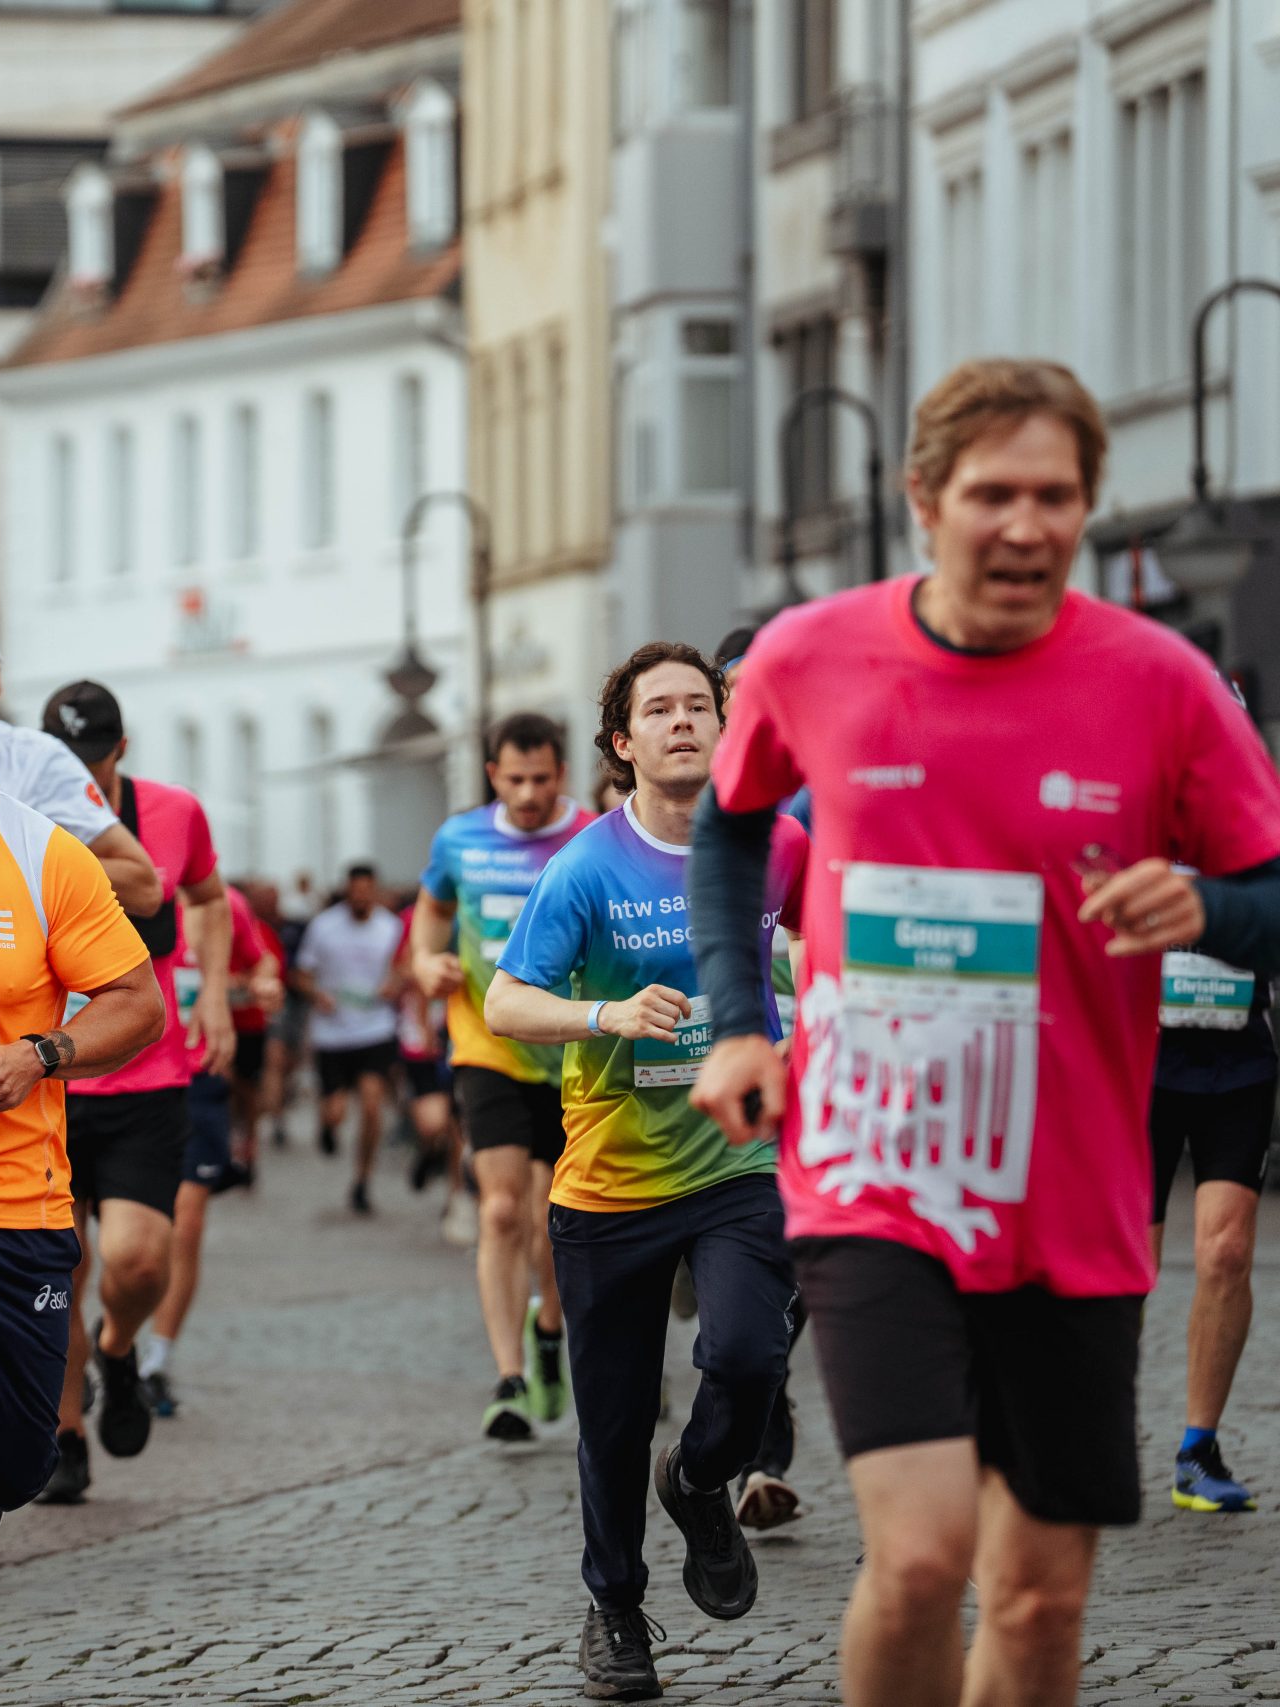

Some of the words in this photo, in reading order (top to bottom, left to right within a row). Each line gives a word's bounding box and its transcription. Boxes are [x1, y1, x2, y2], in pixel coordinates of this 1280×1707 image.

[608, 899, 653, 920] htw
[894, 917, 978, 957] Georg
[1173, 977, 1236, 996] Christian
[673, 1026, 714, 1046] Tobia
